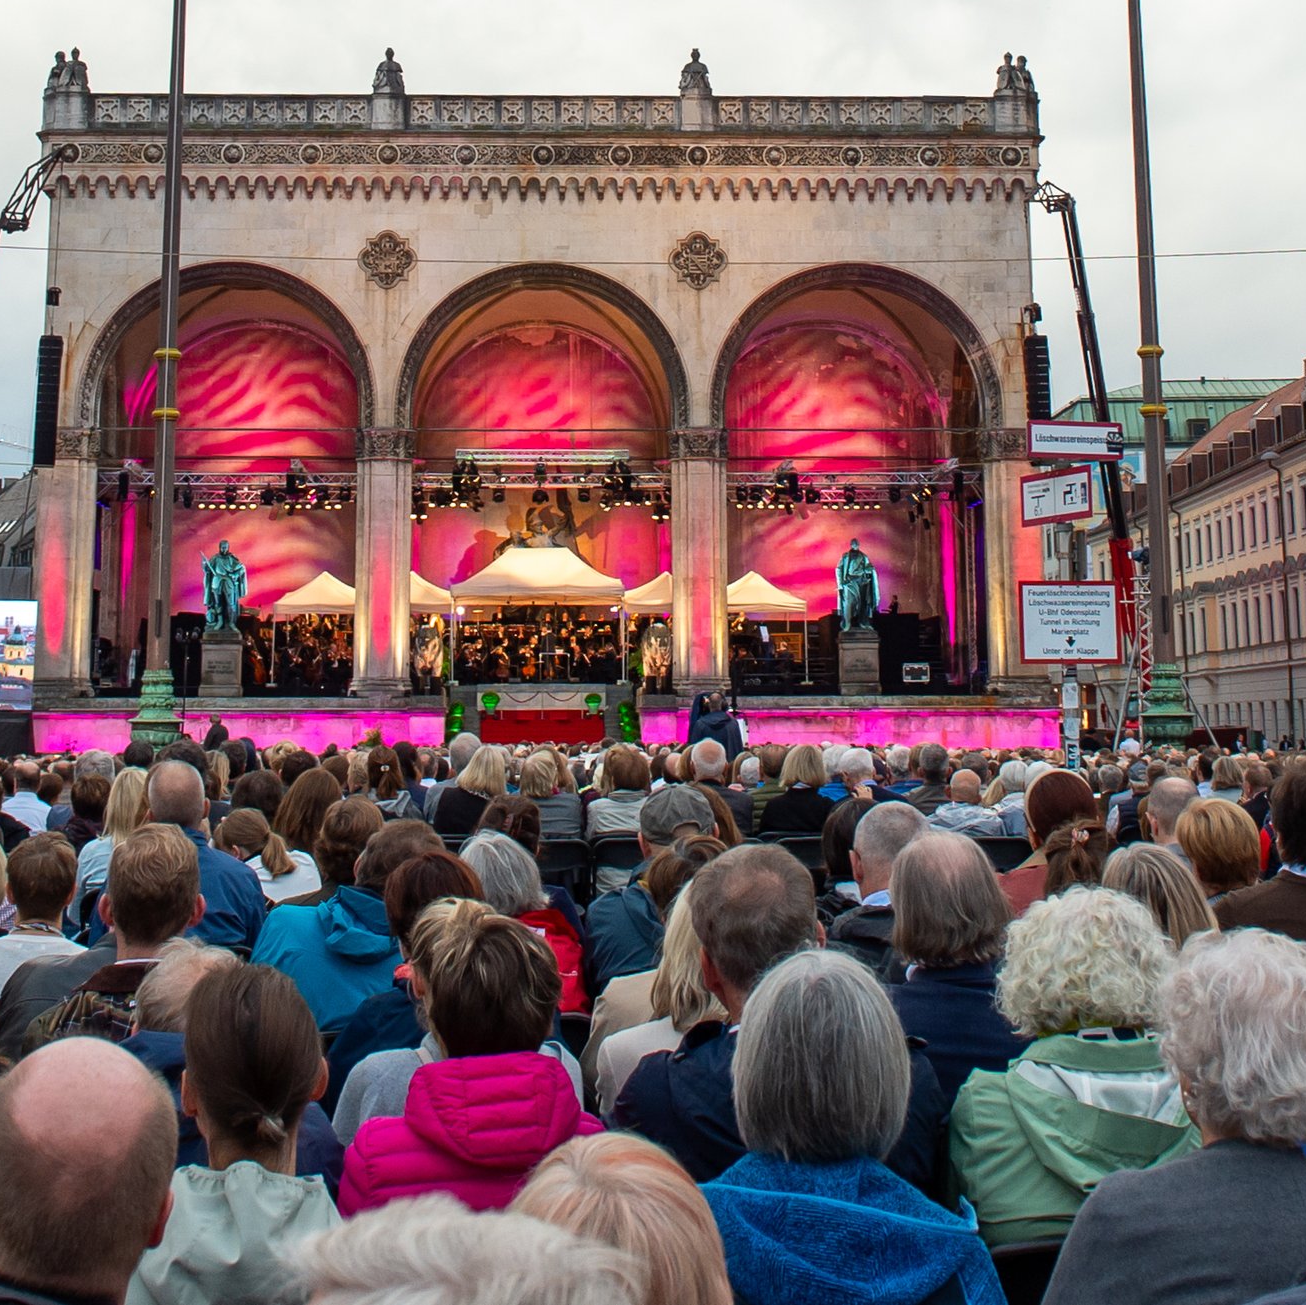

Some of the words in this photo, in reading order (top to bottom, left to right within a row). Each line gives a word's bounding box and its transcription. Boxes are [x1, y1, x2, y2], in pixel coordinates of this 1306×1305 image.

[1060, 608, 1101, 617] Odeonsplatz
[1040, 618, 1061, 626] Tunnel
[1071, 618, 1101, 626] Richtung
[1051, 628, 1090, 636] Marienplatz
[1076, 647, 1099, 655] Klappe
